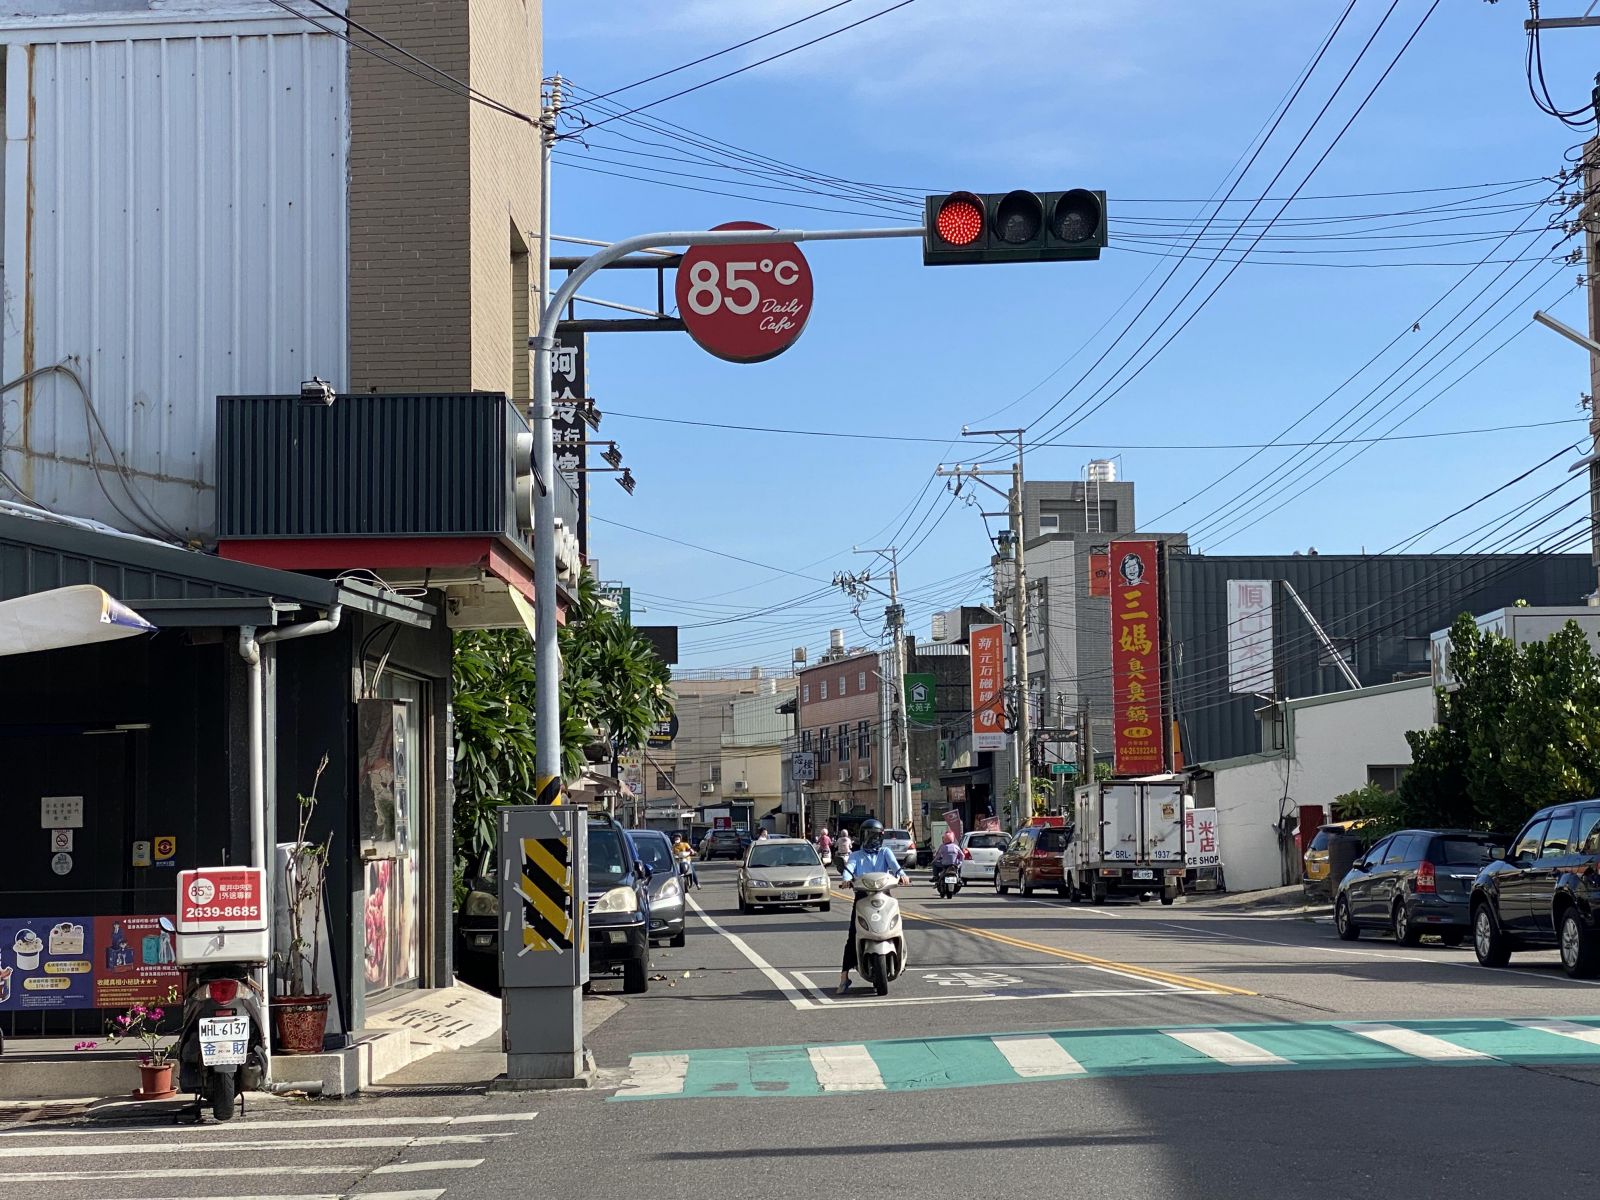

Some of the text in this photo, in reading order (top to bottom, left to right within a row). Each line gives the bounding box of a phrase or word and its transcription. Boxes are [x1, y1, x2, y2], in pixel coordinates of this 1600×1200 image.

[762, 298, 803, 317] Daily
[759, 316, 795, 334] Cafe
[1118, 590, 1153, 723] 三媽臭臭鍋
[906, 703, 932, 712] 大苑子
[1199, 821, 1215, 852] 米店
[1154, 850, 1170, 858] 1937
[1199, 855, 1219, 865] SHOP
[186, 906, 258, 918] 2639-8685
[203, 1041, 246, 1056] 金 財
